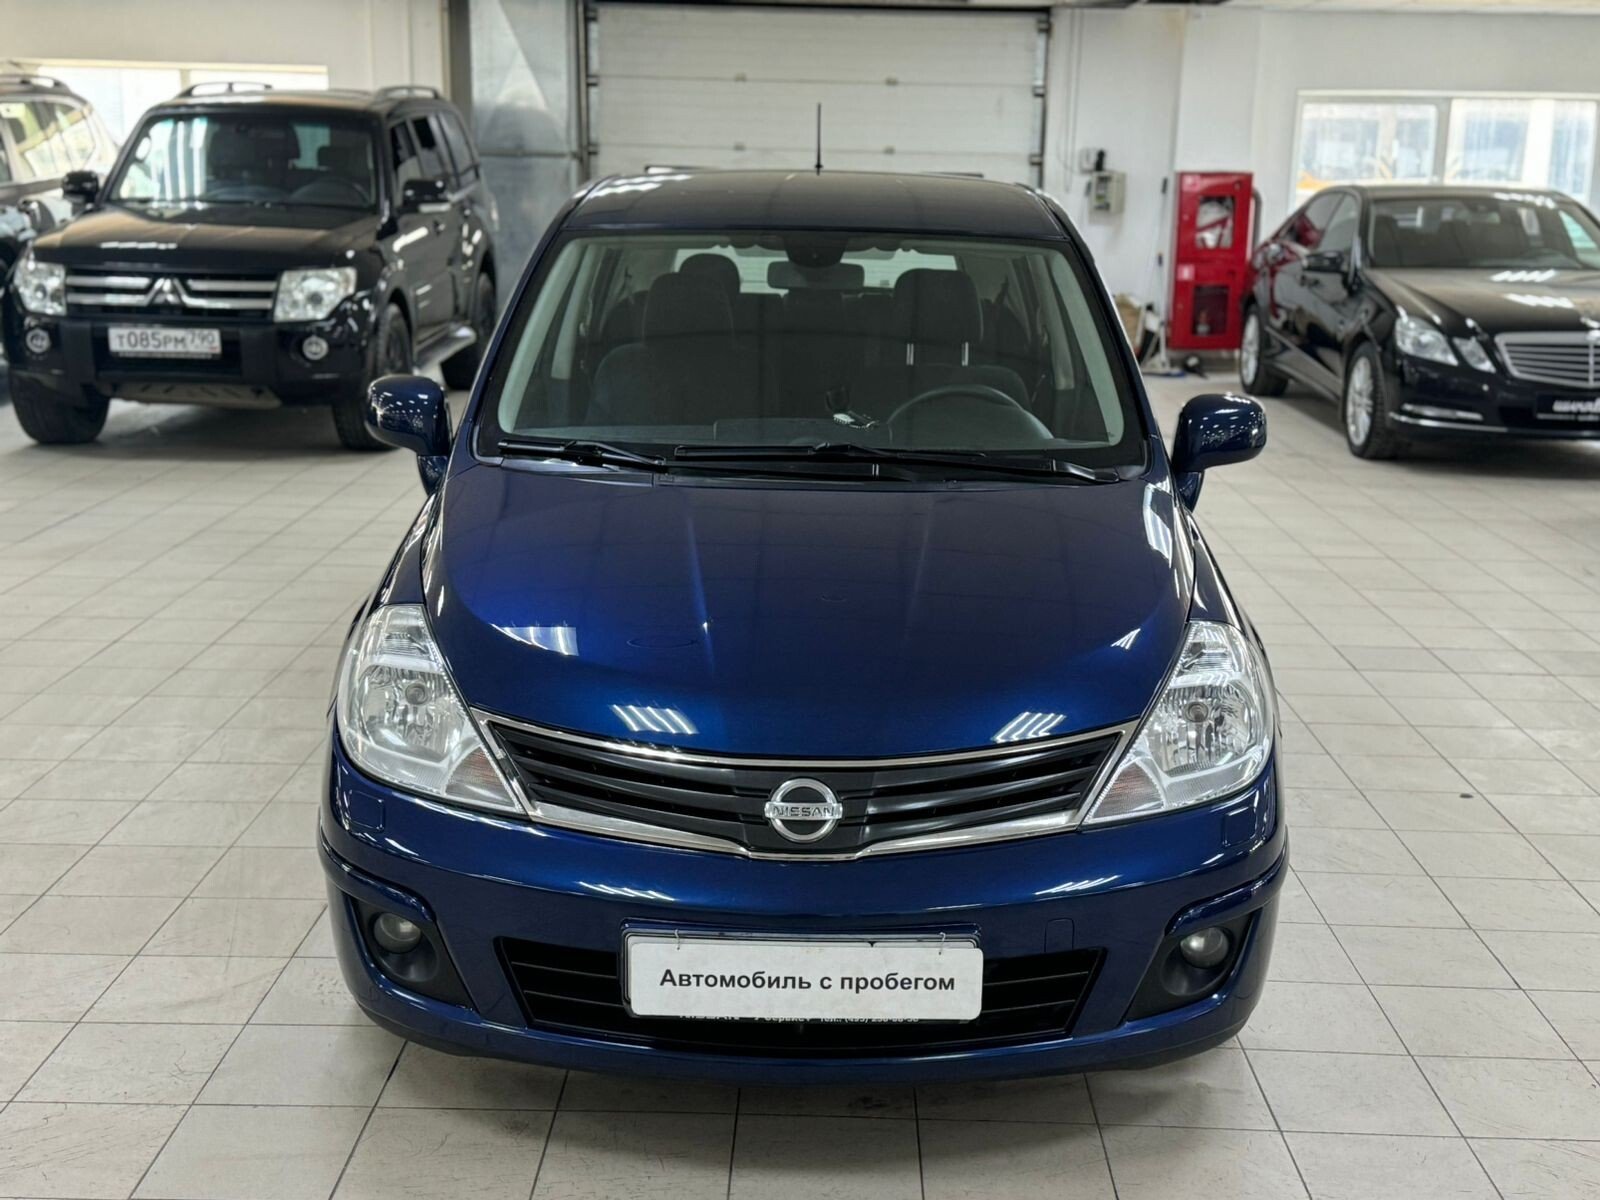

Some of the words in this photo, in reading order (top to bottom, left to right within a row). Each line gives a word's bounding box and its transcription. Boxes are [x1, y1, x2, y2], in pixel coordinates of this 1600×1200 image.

[773, 806, 834, 817] NISSAN
[660, 969, 812, 989] Автомобиль
[820, 976, 833, 990] с
[840, 972, 955, 994] пробегом
